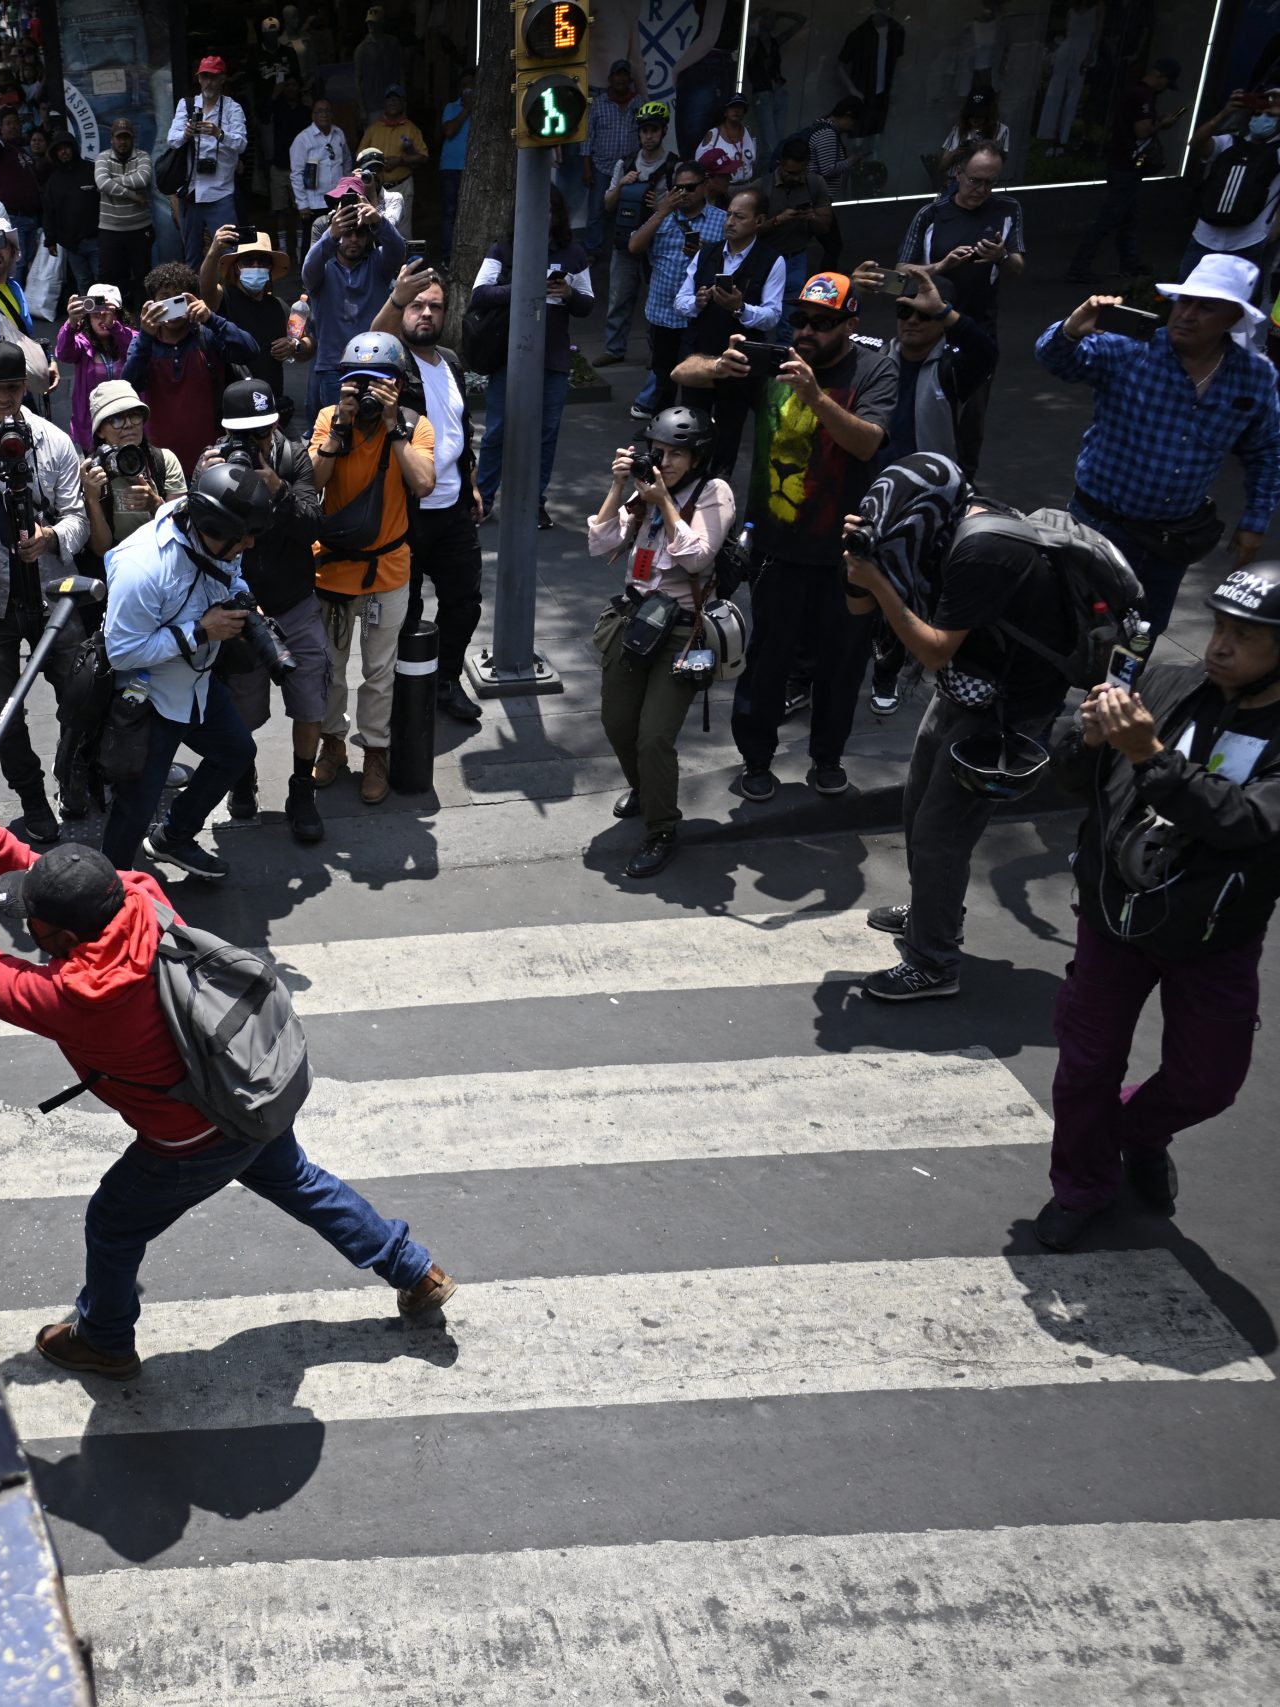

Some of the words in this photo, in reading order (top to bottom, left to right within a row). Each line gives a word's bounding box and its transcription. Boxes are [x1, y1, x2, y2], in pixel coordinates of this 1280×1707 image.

[554, 4, 576, 49] 6
[63, 85, 97, 139] FASHION
[1226, 570, 1275, 595] CDMX
